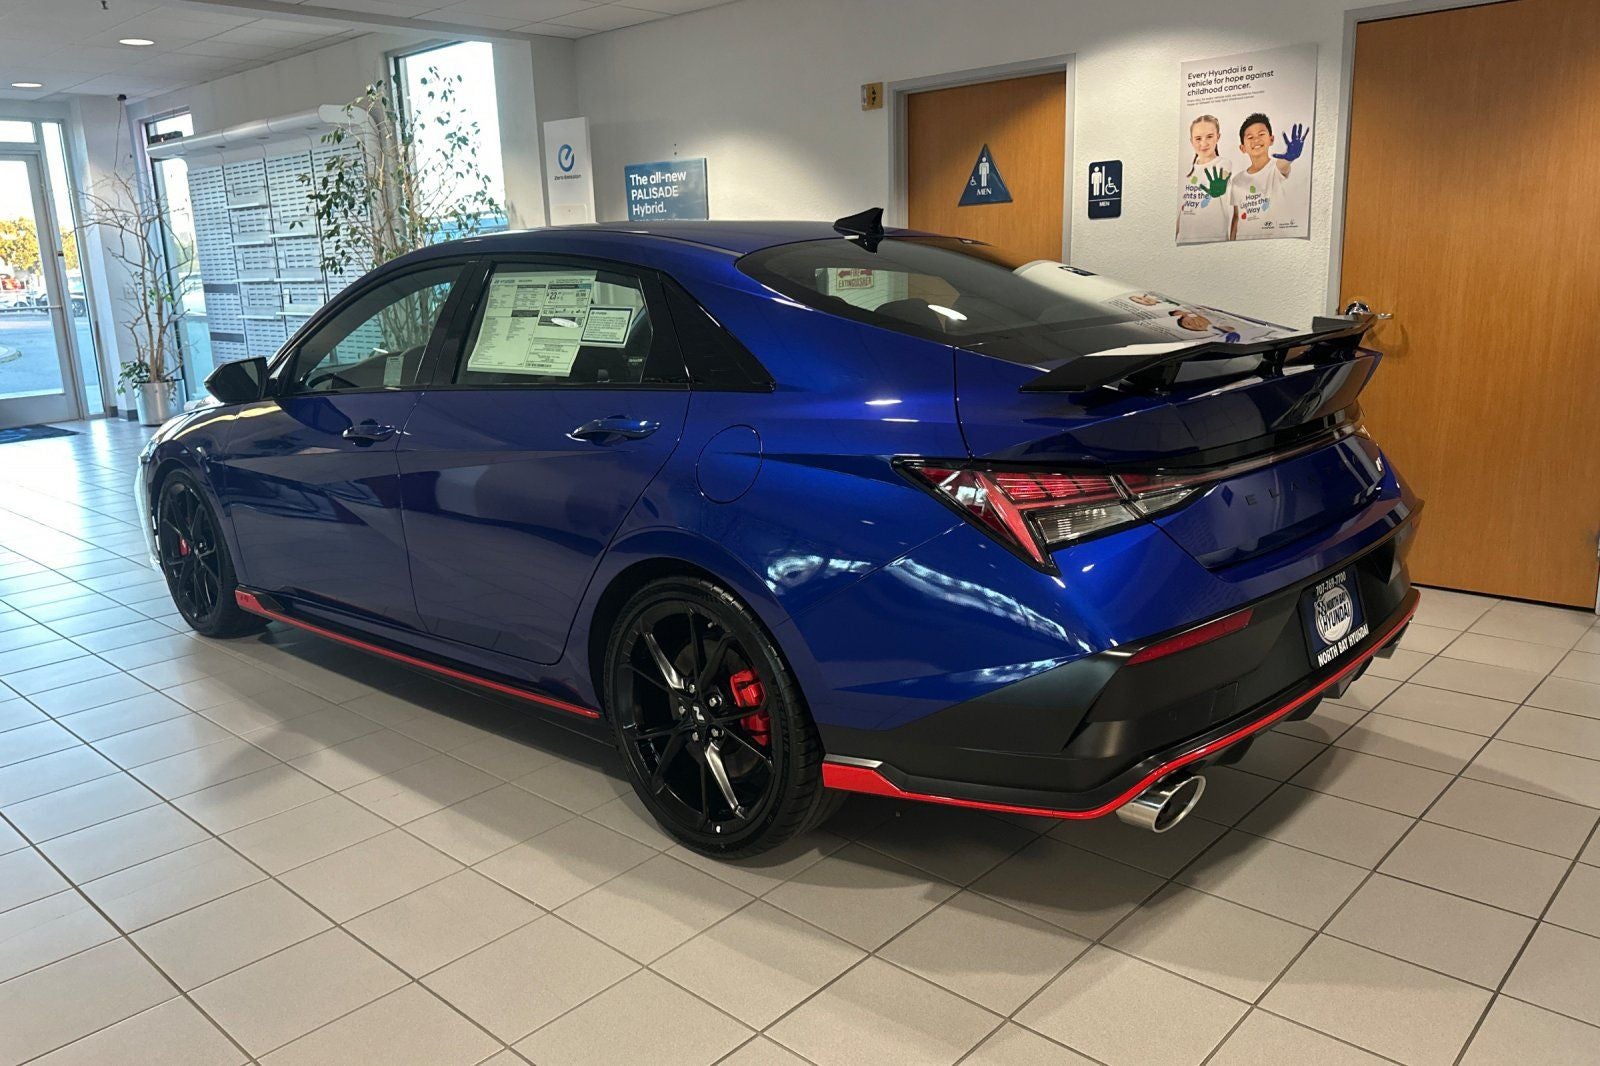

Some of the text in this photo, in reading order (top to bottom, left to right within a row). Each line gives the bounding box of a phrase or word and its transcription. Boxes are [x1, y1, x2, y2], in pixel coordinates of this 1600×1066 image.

[1187, 71, 1208, 80] Every
[1208, 66, 1239, 77] Hyundai
[1187, 77, 1213, 88] vehicle
[1224, 74, 1244, 83] hope
[1245, 70, 1275, 81] against
[1187, 86, 1223, 97] childhood
[1223, 82, 1252, 92] cancer.
[630, 171, 687, 186] The all-new
[631, 185, 679, 201] PALISADE
[976, 187, 992, 196] MEN
[632, 201, 667, 217] Hybrid.
[1317, 623, 1370, 667] NORTH BAY HYUNDAI
